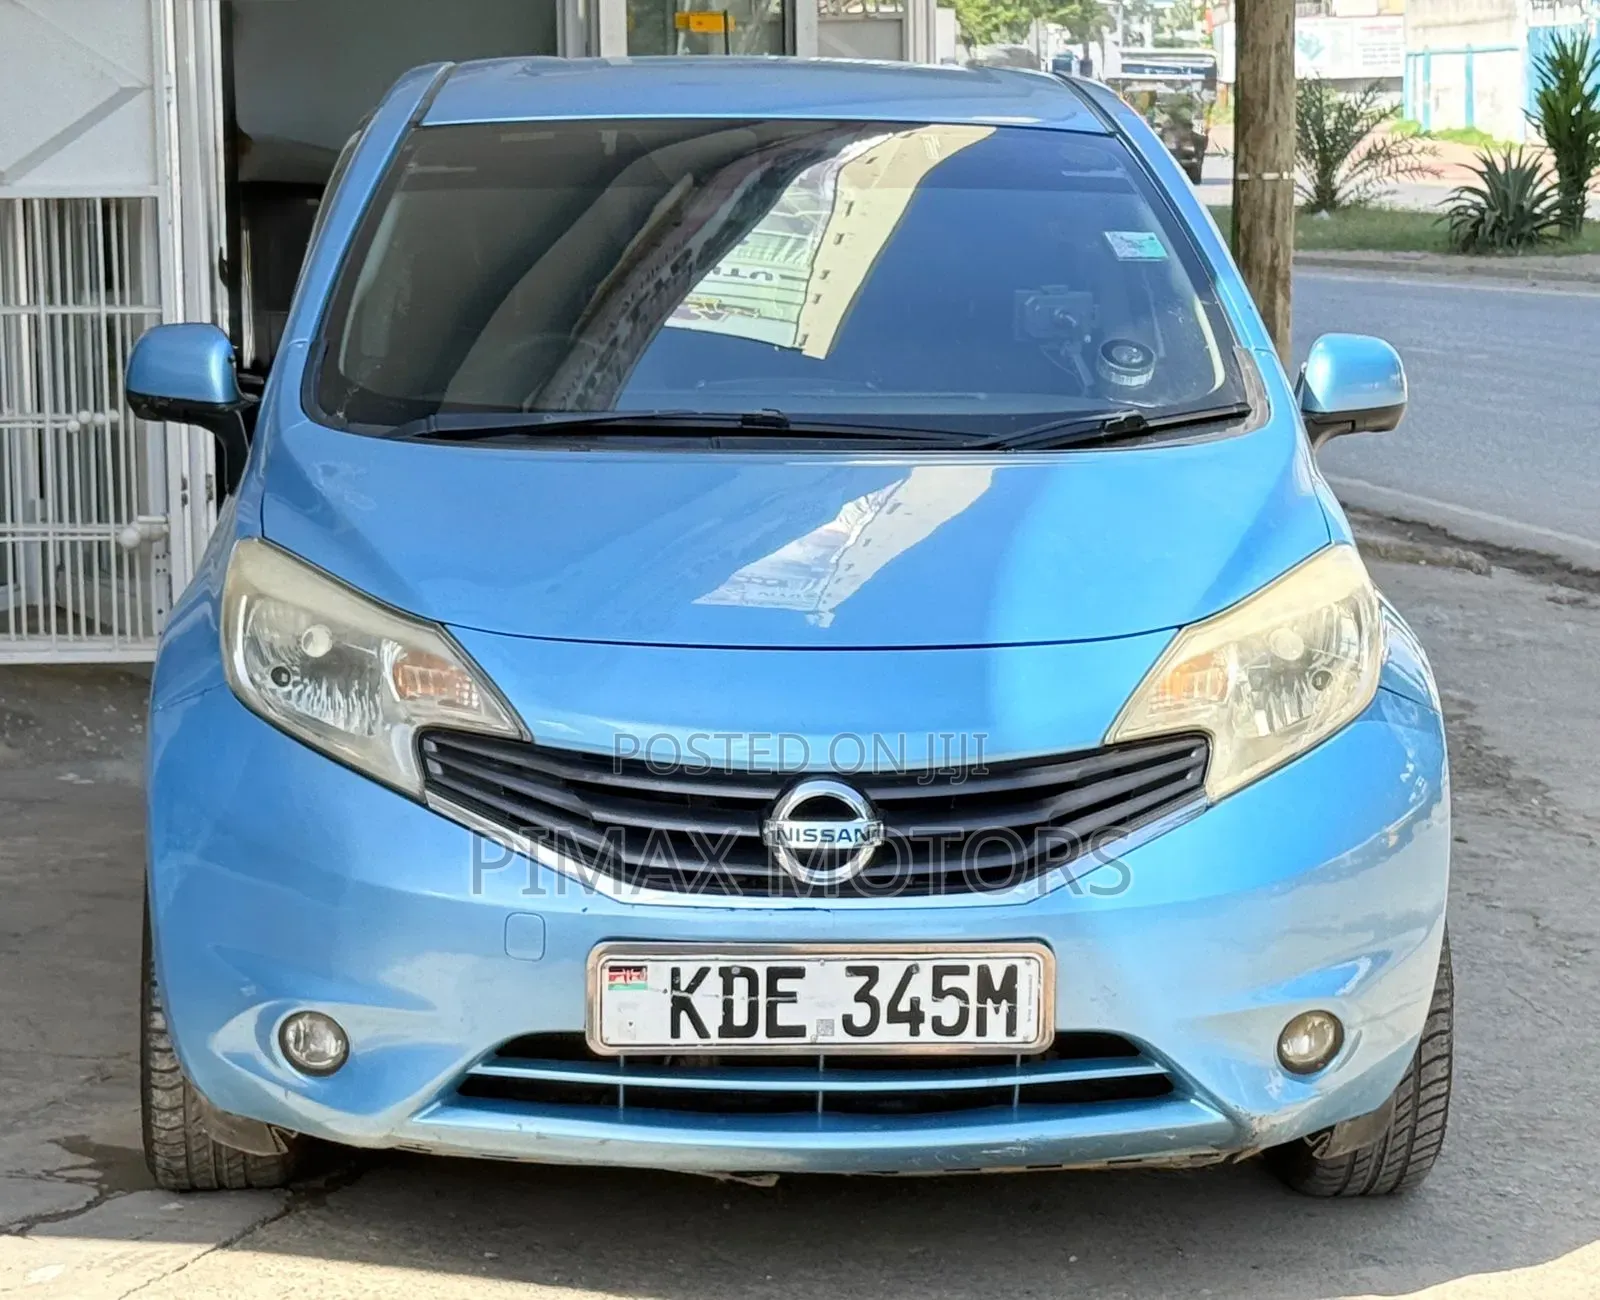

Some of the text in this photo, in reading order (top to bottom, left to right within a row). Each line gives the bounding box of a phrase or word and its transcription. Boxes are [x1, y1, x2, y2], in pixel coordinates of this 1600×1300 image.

[776, 827, 873, 843] NISSAN
[669, 964, 807, 1039] KDE
[841, 964, 1018, 1038] 345M
